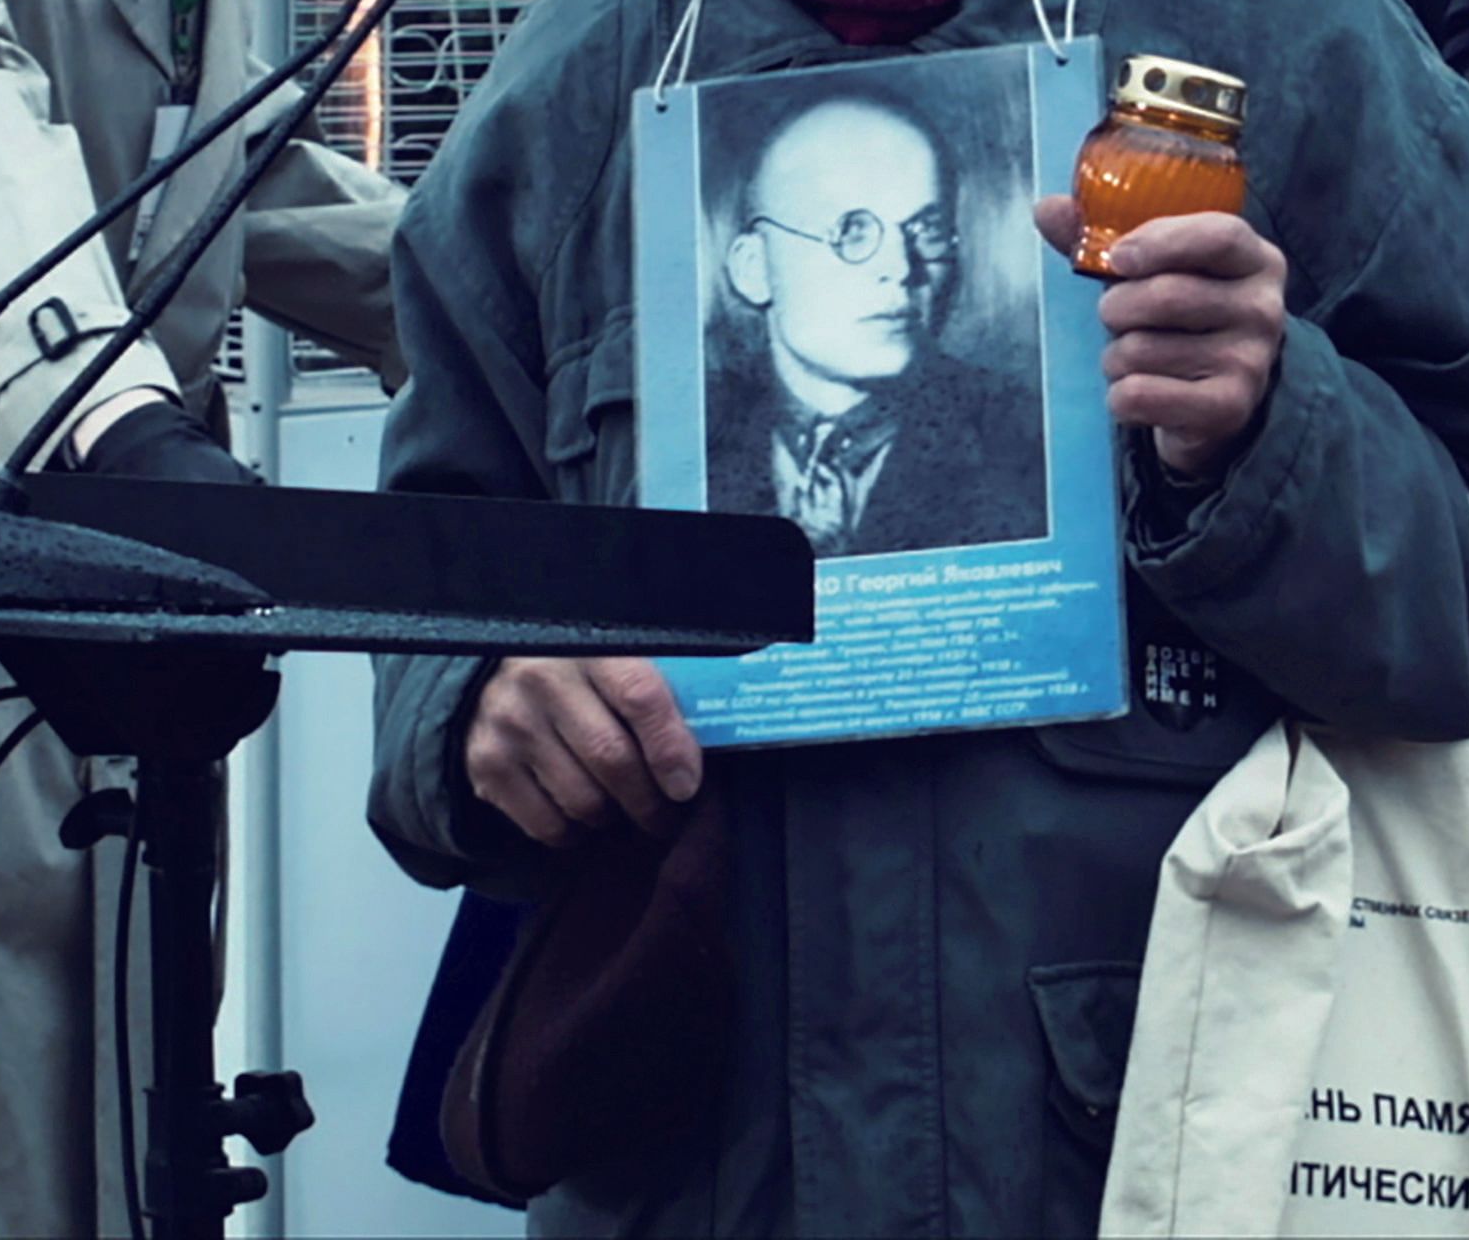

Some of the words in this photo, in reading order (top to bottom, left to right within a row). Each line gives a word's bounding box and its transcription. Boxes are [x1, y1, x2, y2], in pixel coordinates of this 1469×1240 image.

[846, 567, 938, 592] Георгий
[942, 559, 1063, 584] Яковлевич
[1305, 1087, 1362, 1123] НЬ
